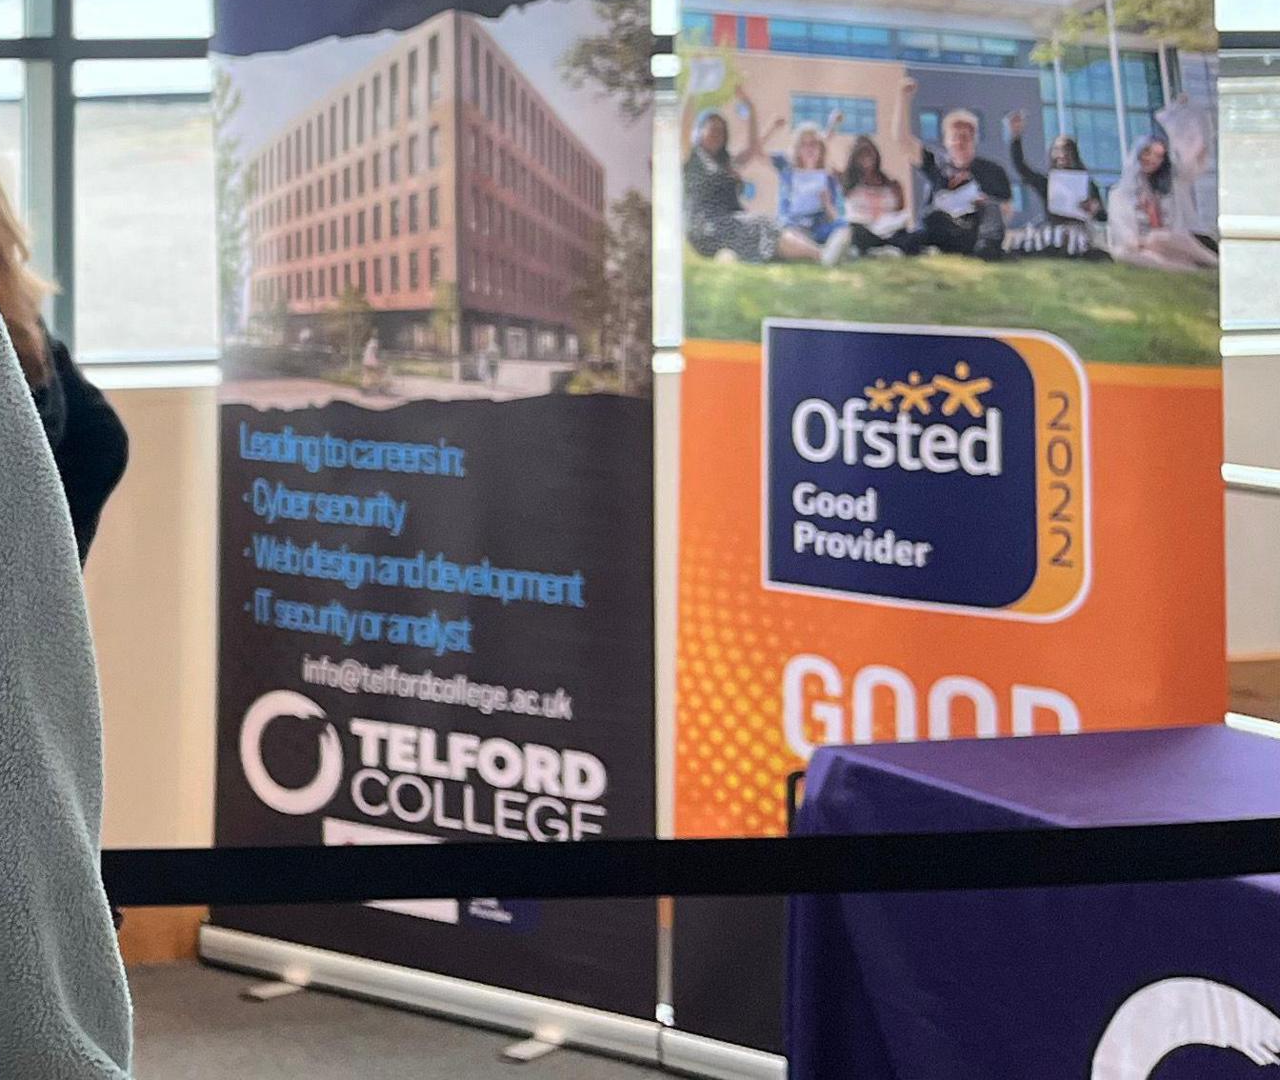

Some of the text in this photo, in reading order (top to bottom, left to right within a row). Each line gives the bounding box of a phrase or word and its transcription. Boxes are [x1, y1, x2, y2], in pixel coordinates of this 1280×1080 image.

[239, 421, 321, 473] Leading
[323, 432, 347, 469] to
[349, 438, 436, 475] careers
[792, 398, 1002, 476] Ofsted
[252, 477, 408, 536] Cyber security
[792, 481, 878, 522] Good
[1046, 391, 1074, 569] 2022
[252, 532, 585, 608] Web design and development
[793, 520, 933, 567] Provider
[253, 587, 474, 657] IT security or analyst
[303, 654, 573, 721] info@telfordcollege.ac.uk
[349, 718, 608, 801] TELFORD
[350, 769, 608, 842] COLLEGE
